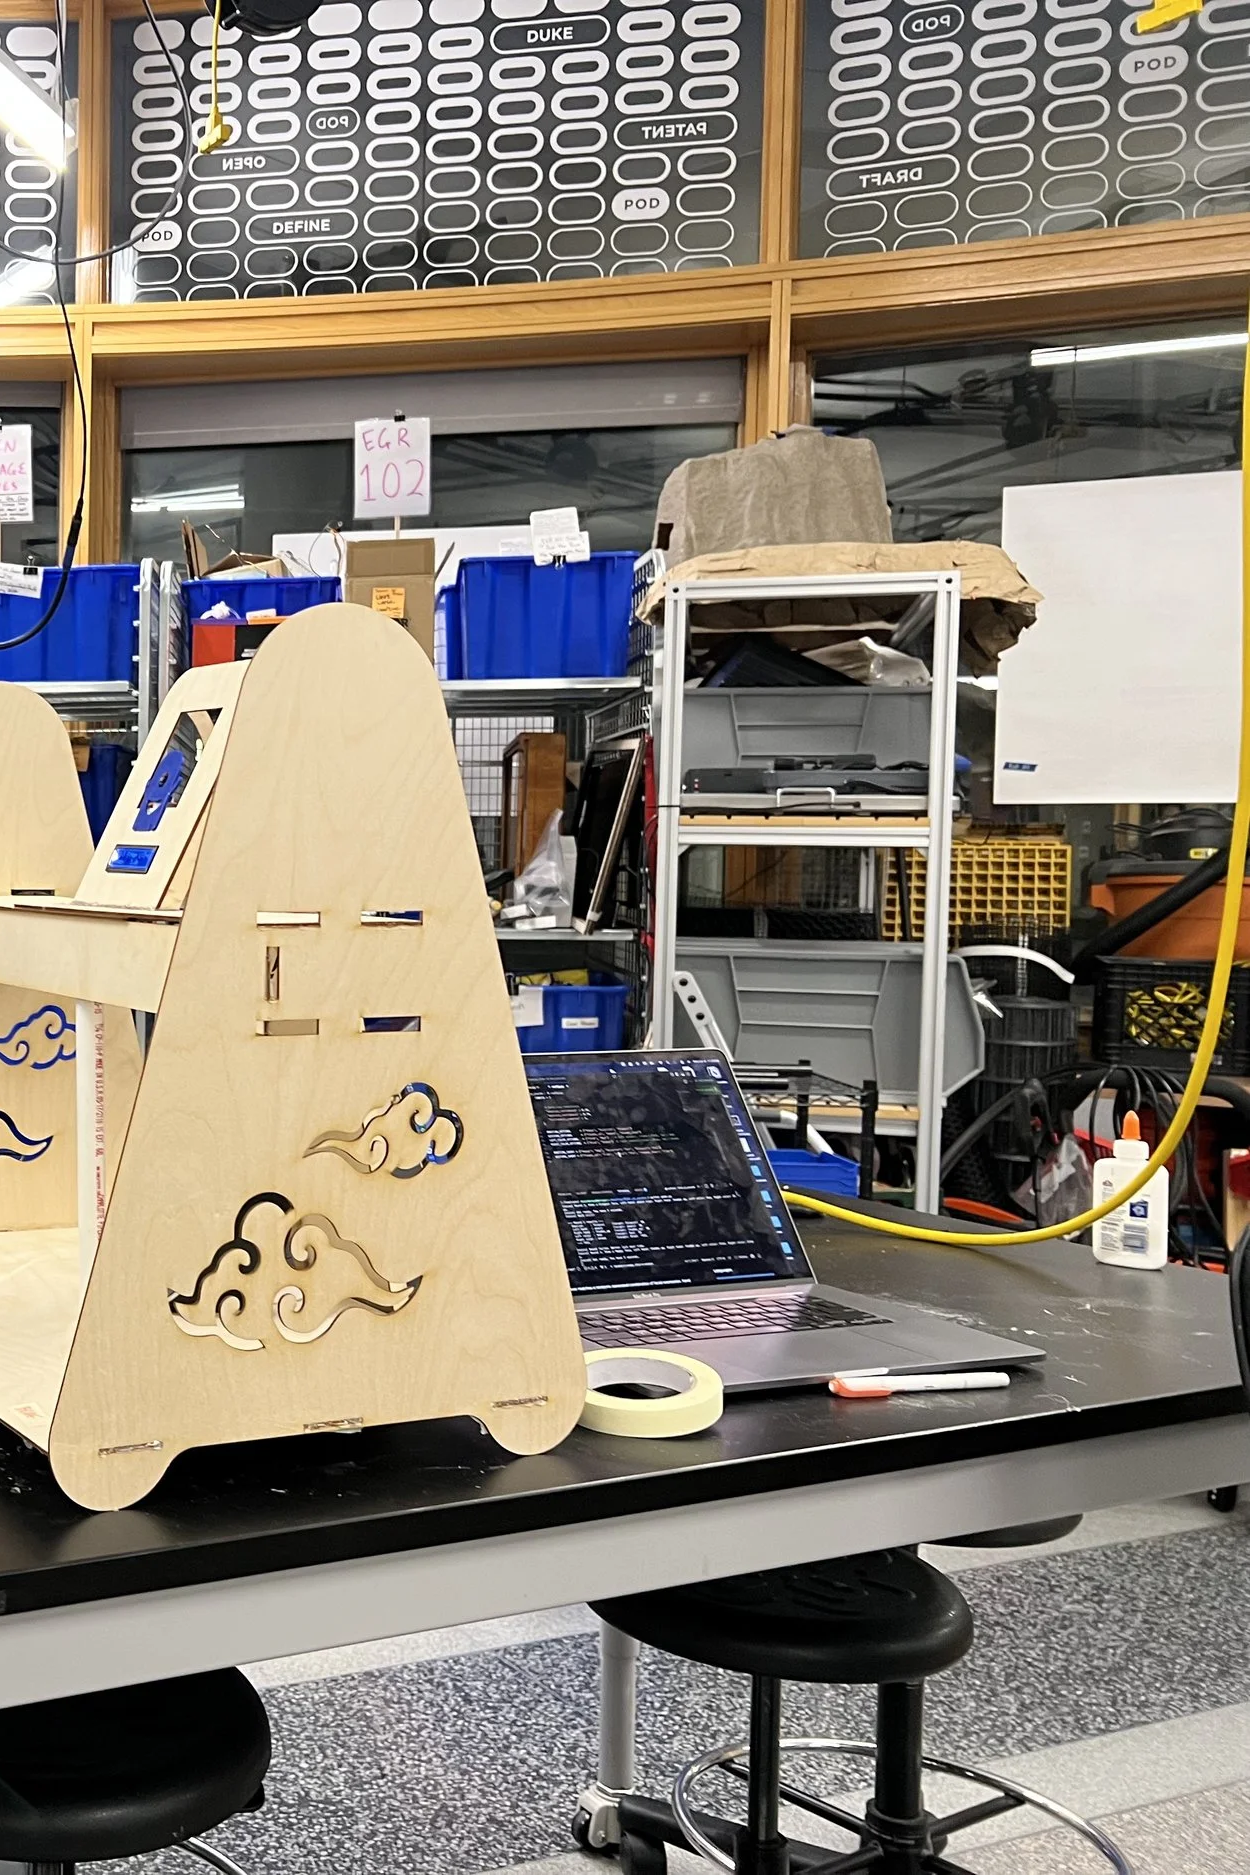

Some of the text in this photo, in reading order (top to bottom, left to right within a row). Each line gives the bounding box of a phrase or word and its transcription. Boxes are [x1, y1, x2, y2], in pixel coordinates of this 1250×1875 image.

[526, 26, 574, 44] DUKE
[1133, 56, 1177, 73] POD
[624, 197, 660, 211] POD
[272, 218, 331, 235] DEFINE
[141, 230, 174, 242] POD
[362, 427, 411, 452] EGR
[360, 458, 424, 501] 102
